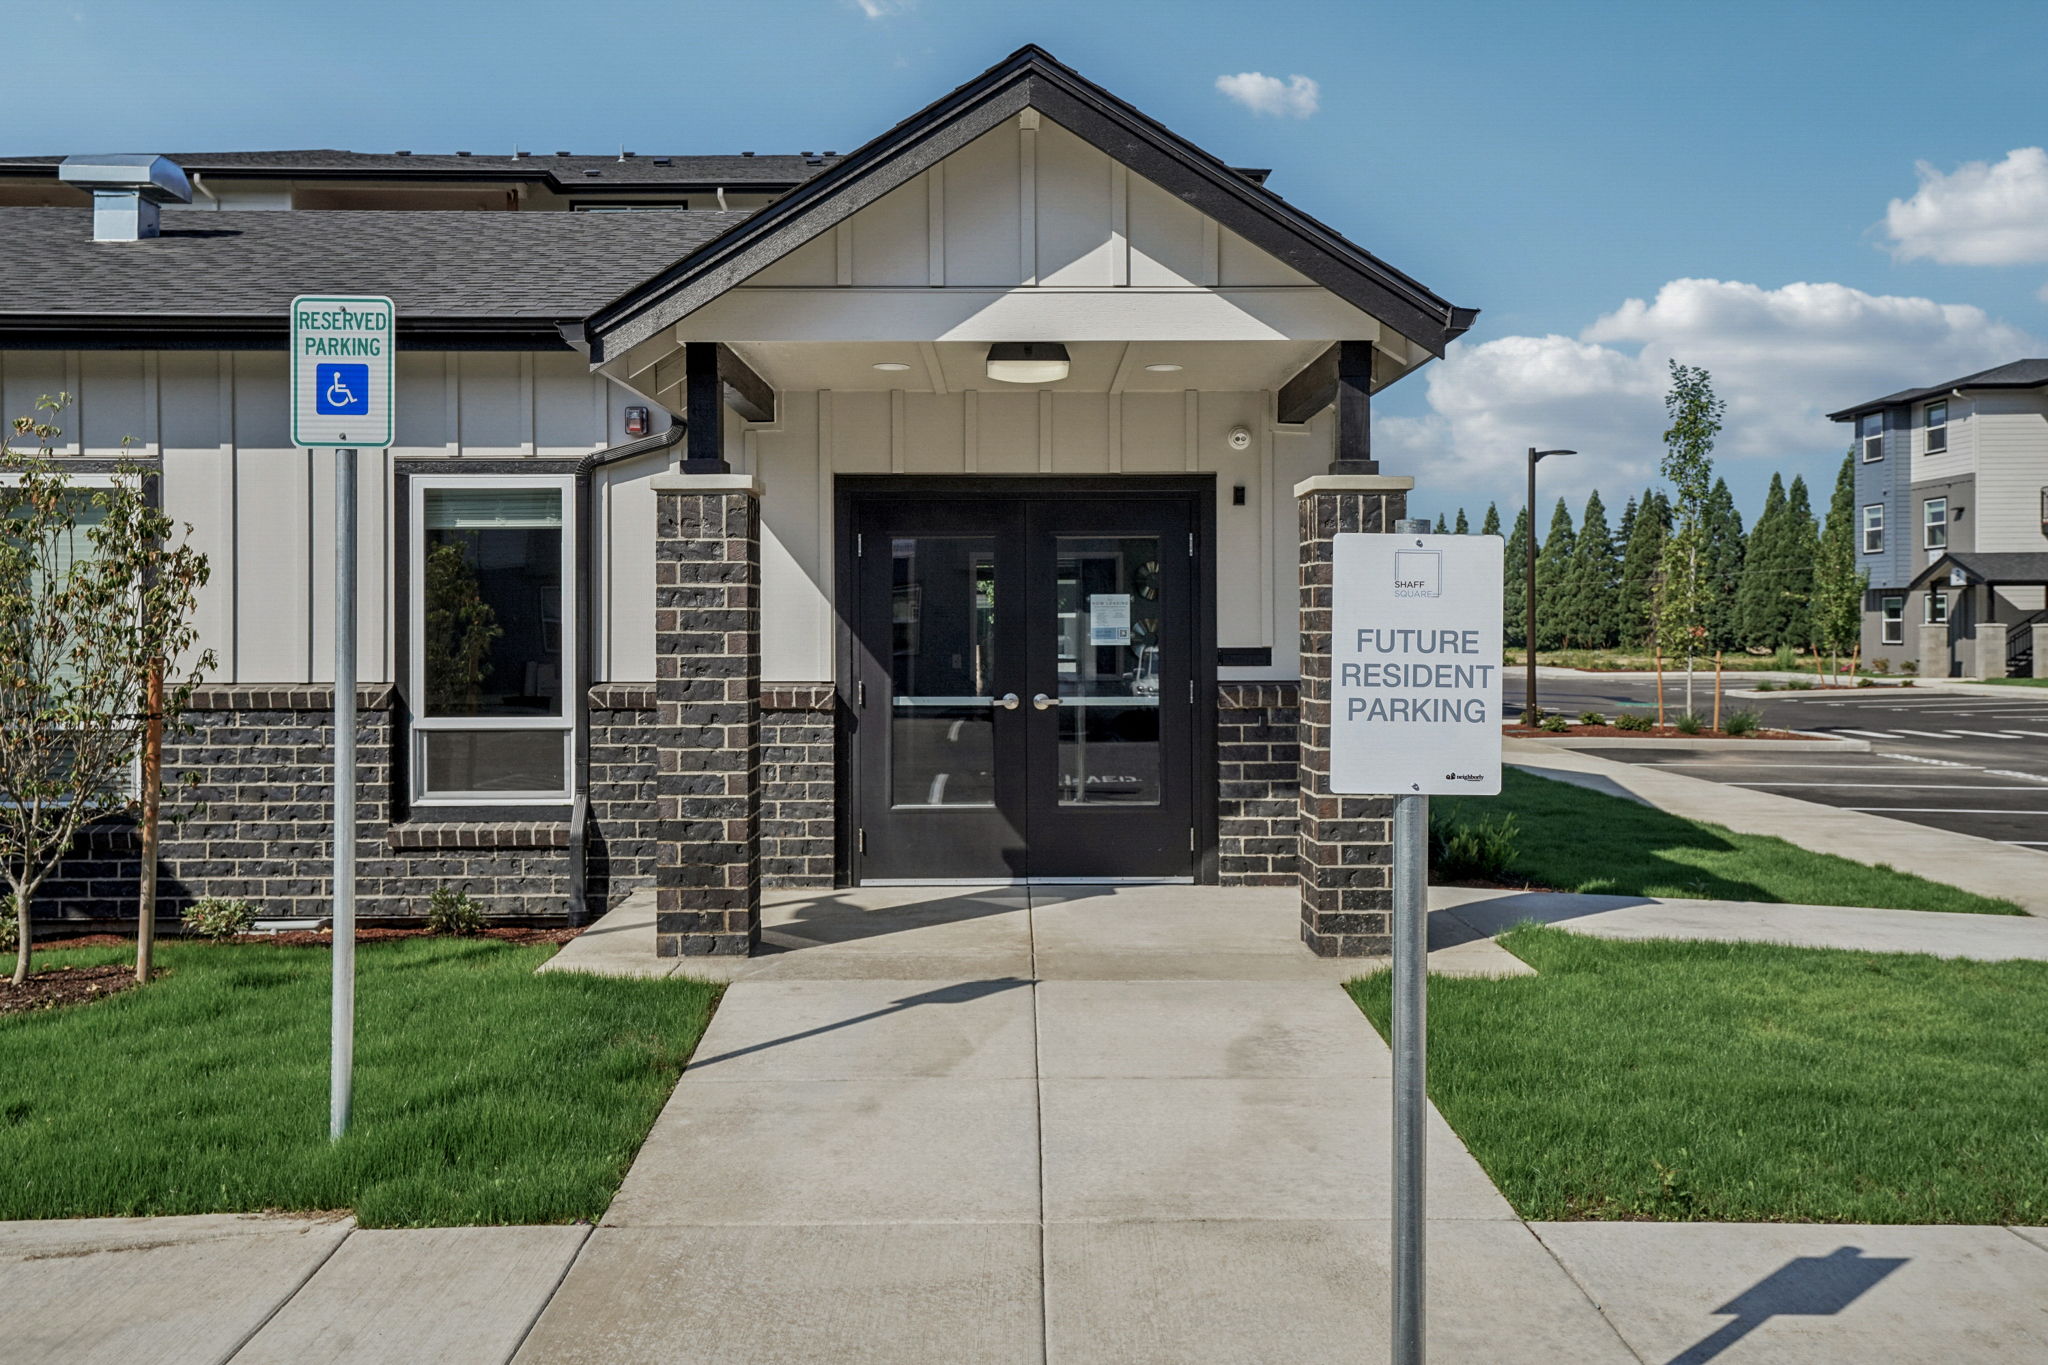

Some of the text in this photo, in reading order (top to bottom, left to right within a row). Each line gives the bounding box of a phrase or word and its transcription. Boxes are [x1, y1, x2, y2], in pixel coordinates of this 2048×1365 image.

[299, 311, 387, 331] RESERVED
[305, 337, 381, 356] PARKING
[1394, 580, 1425, 589] SHAFF
[1394, 590, 1433, 598] SQUARE
[1357, 628, 1480, 654] FUTURE
[1341, 662, 1495, 689] RESIDENT
[1347, 697, 1487, 724] PARKING
